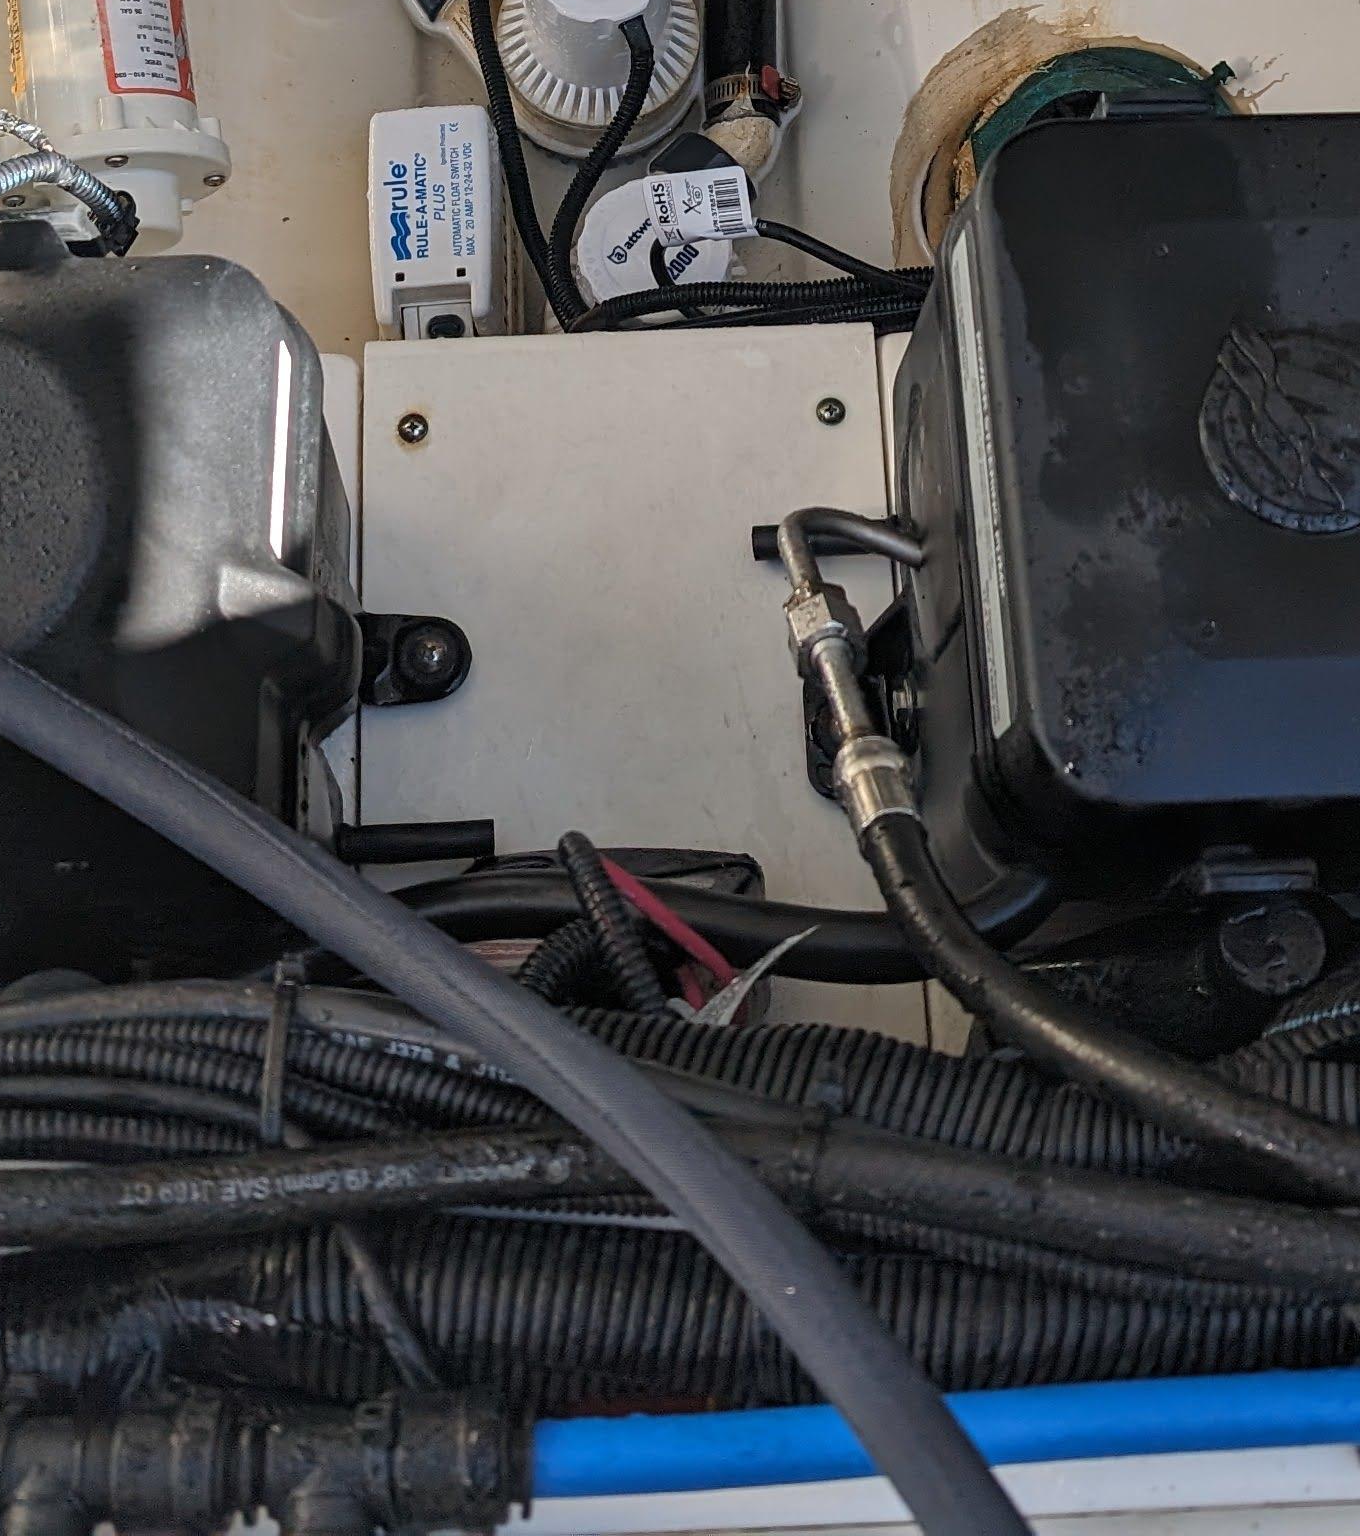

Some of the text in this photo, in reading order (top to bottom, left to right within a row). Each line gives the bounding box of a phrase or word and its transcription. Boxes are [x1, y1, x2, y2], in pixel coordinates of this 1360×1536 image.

[449, 147, 460, 179] SWITCH
[462, 142, 472, 160] VDC
[450, 181, 461, 207] FLOAT
[463, 161, 474, 196] 12-24-32
[432, 183, 446, 222] PLUS
[464, 199, 474, 218] AMP
[652, 183, 671, 225] RoHS
[451, 208, 462, 257] AUTOMATIC
[465, 220, 475, 230] 20
[667, 243, 700, 281] 2000
